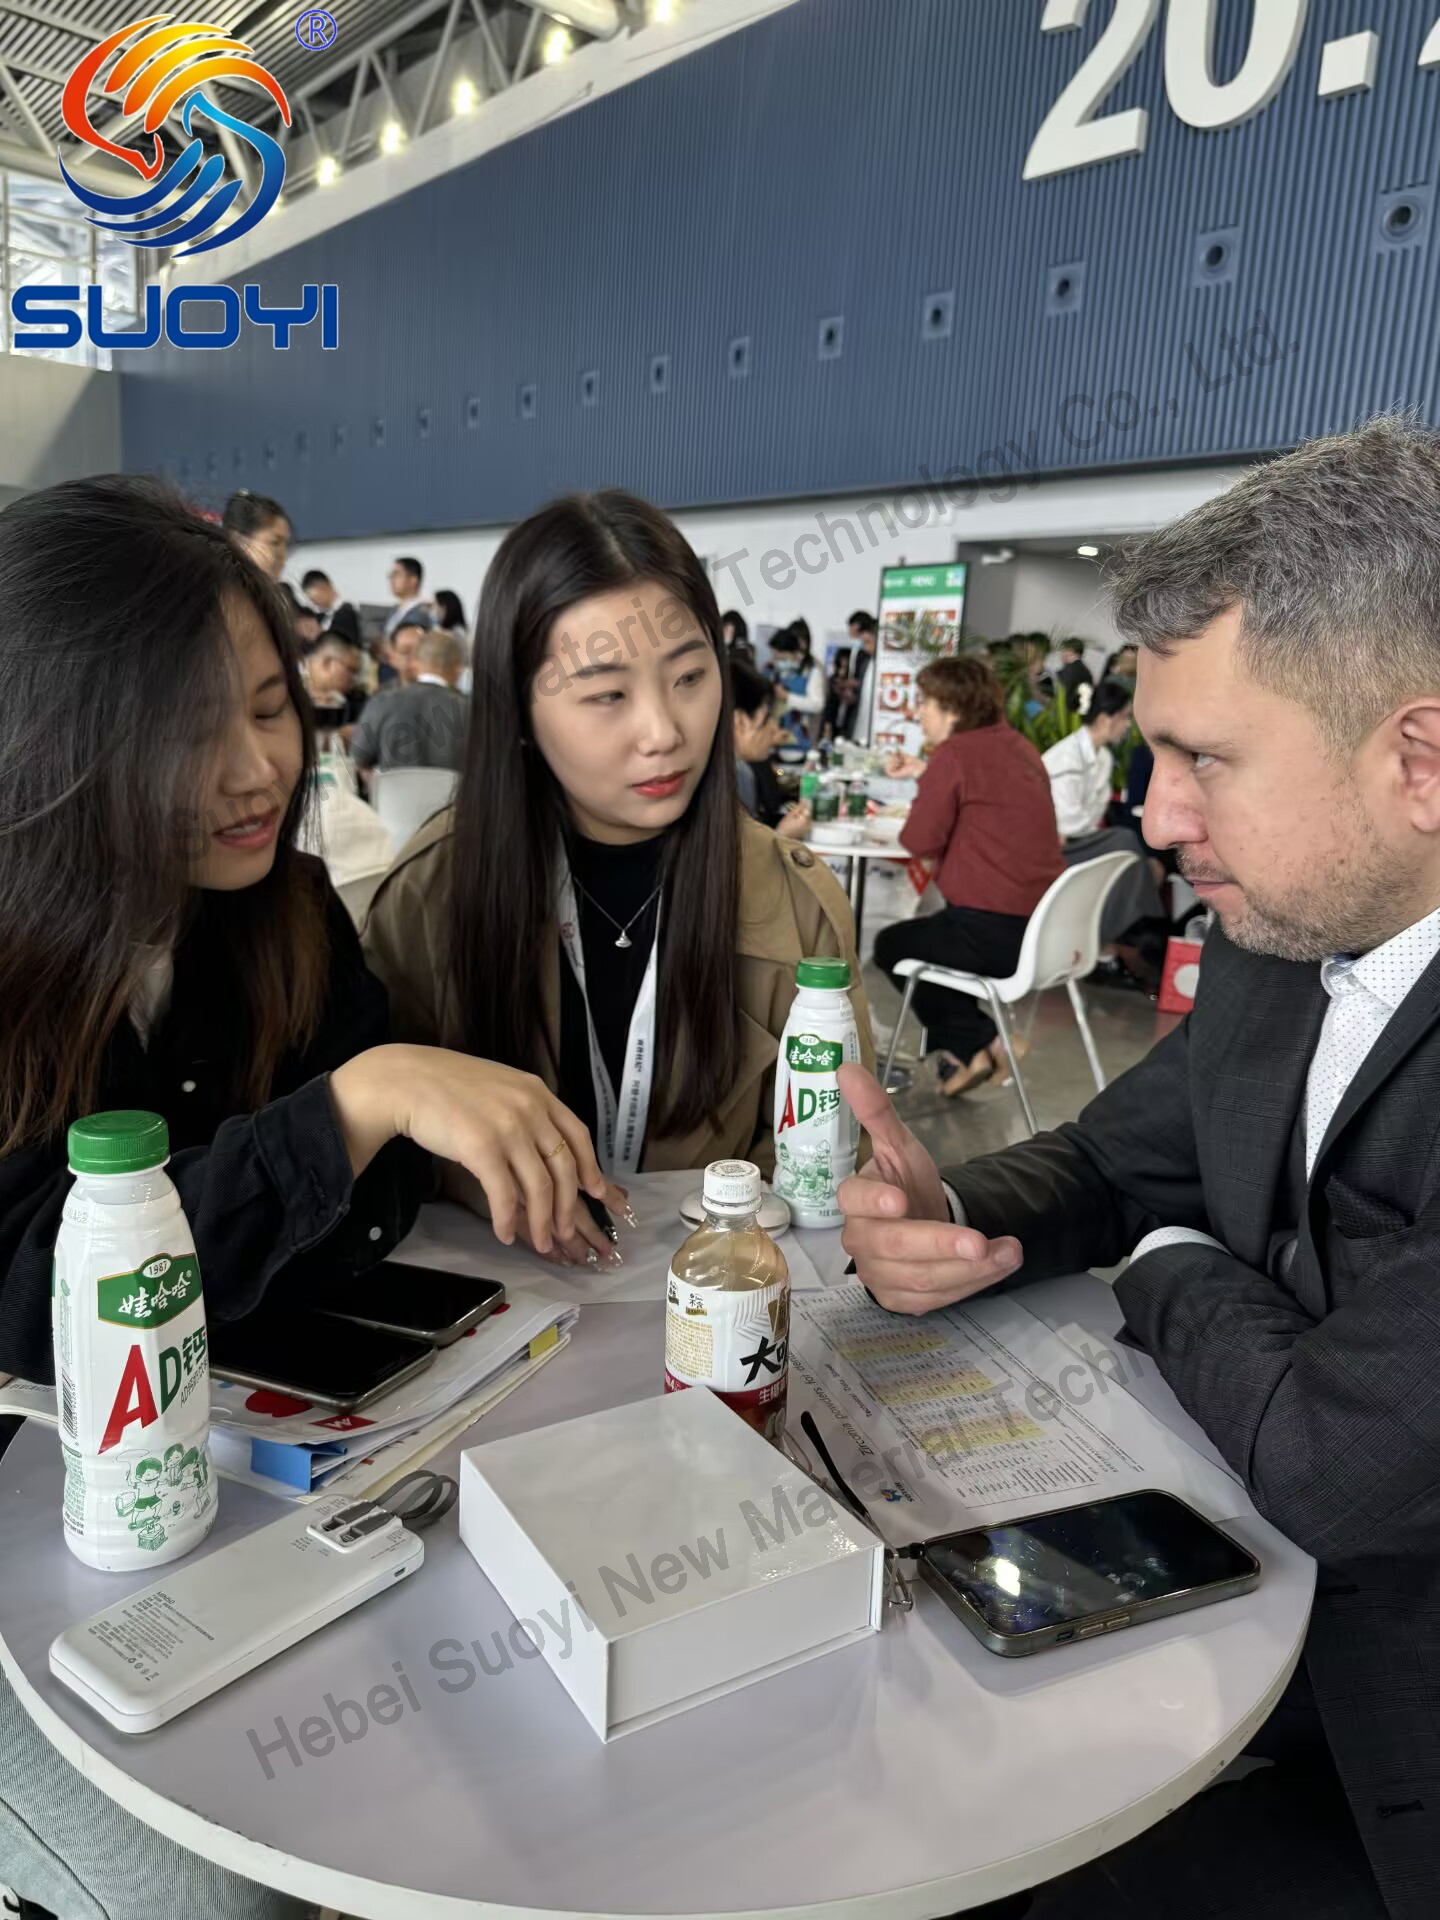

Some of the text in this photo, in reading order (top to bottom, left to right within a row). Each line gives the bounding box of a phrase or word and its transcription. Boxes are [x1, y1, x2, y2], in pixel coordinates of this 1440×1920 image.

[1022, 0, 1440, 181] 20.
[149, 1262, 168, 1275] 1987
[118, 1271, 191, 1318] 娃哈哈
[801, 1374, 816, 1385] for
[813, 1386, 848, 1421] powders
